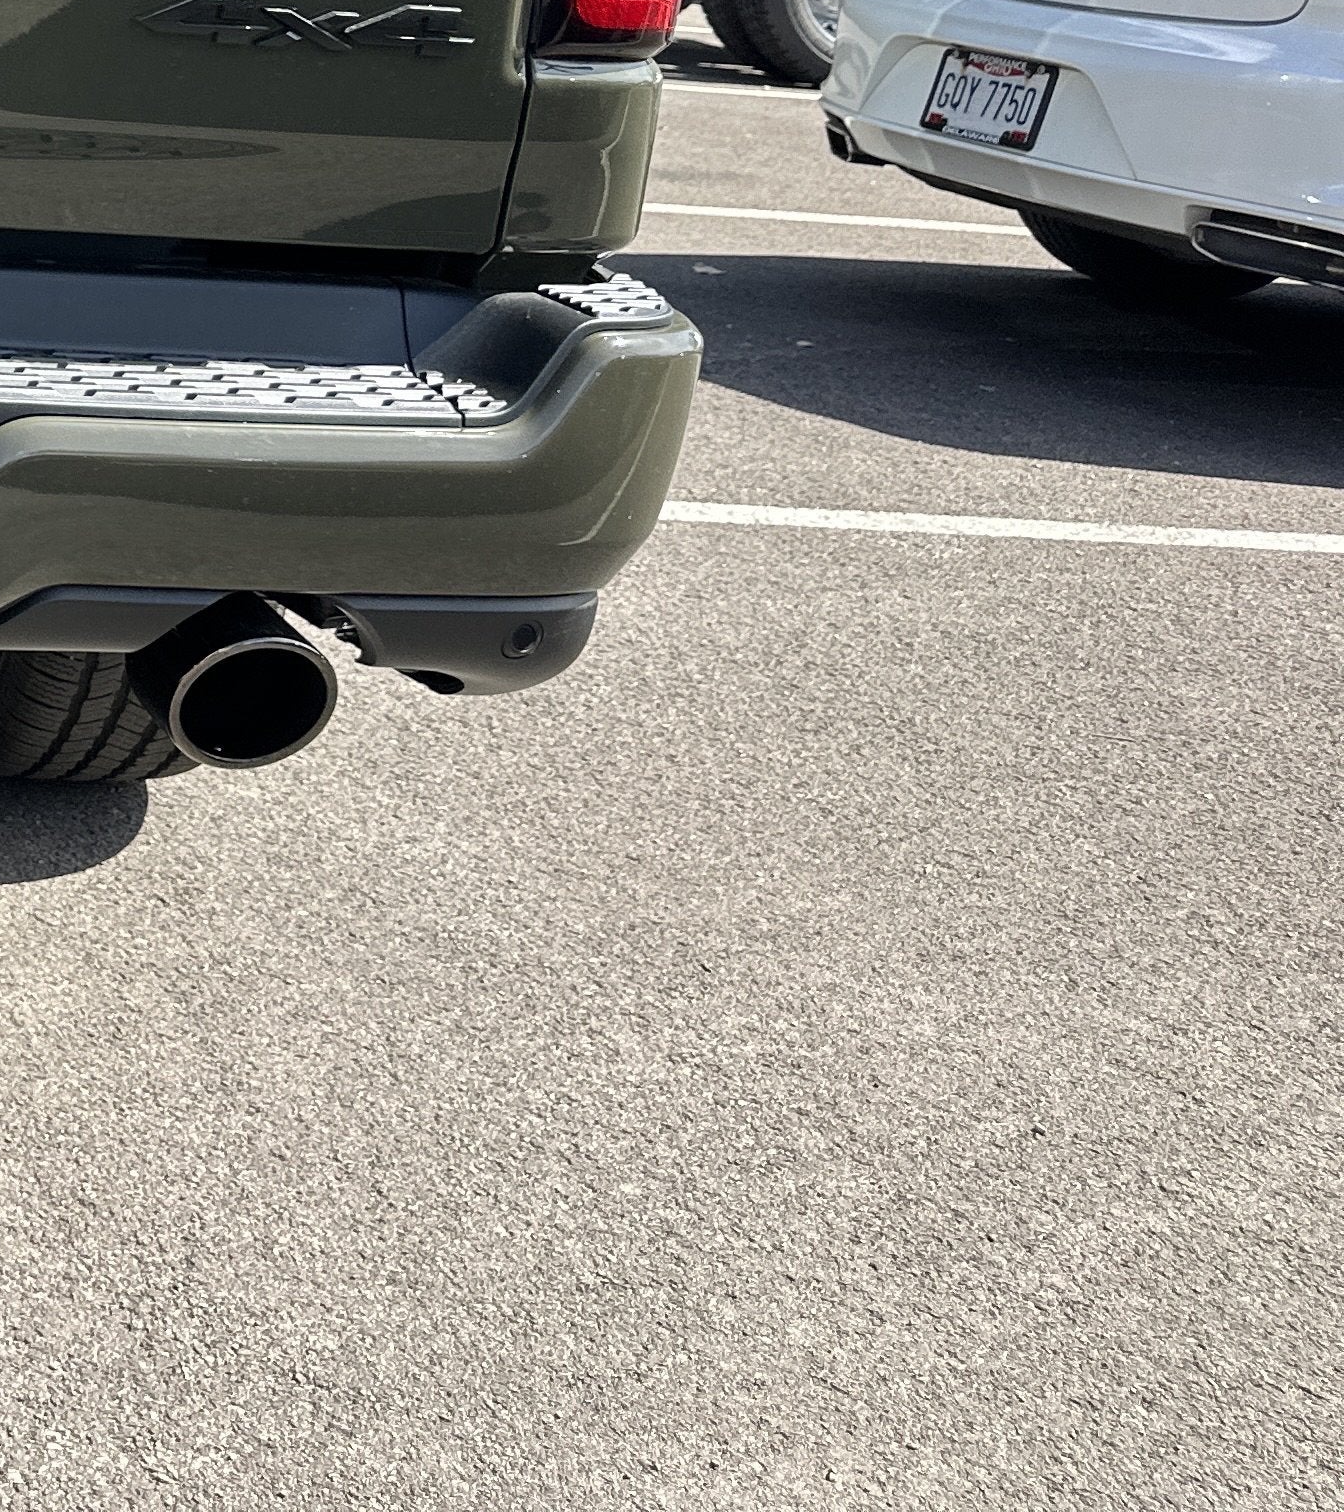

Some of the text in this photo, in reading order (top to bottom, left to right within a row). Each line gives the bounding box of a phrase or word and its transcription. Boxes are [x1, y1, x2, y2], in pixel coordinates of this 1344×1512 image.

[937, 72, 1037, 125] GQY 7750
[942, 125, 1000, 144] DELAWARE
